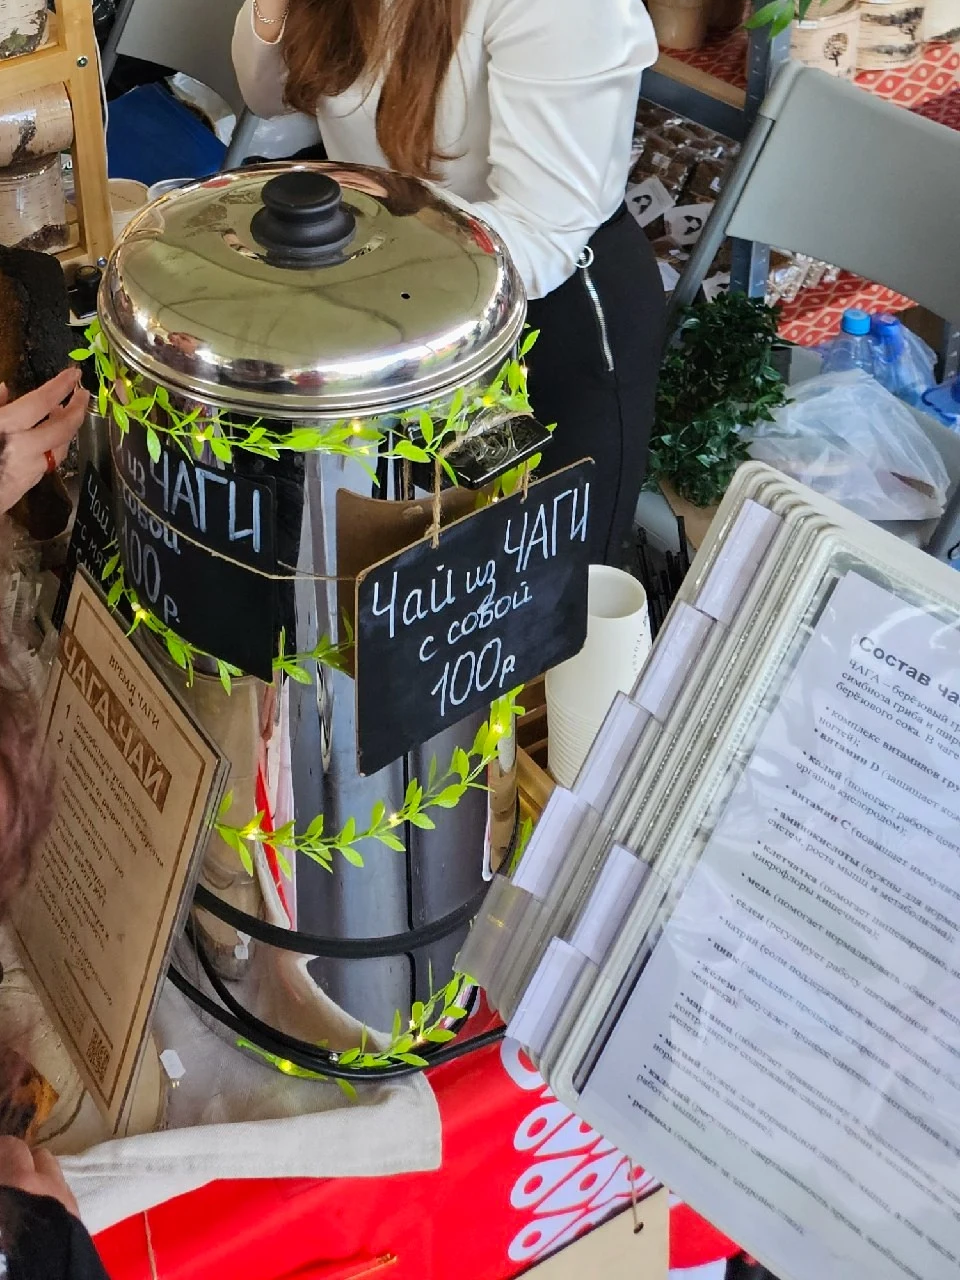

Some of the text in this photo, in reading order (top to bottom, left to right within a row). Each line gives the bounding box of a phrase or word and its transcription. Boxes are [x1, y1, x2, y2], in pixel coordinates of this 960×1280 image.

[149, 451, 262, 553] ЧАГИ
[371, 482, 591, 639] Чай из ЧАГИ
[419, 635, 438, 662] с
[856, 633, 960, 705] Состав ча
[58, 633, 166, 804] ЧАГА-ЧАЙ
[107, 653, 160, 731] ВРЕМЯ ЧАГИ
[832, 679, 895, 723] берёзового
[893, 717, 923, 738] сока.
[923, 733, 935, 745] В
[839, 669, 960, 749] симбиоза гриба и шир
[846, 658, 960, 735] ЧАГА берёзовый гр
[55, 729, 65, 750] 2
[817, 730, 869, 766] витамин
[868, 760, 881, 773] D
[829, 709, 960, 795] комплекс витаминов гру
[787, 787, 840, 824] витамин
[848, 825, 909, 869] (повышает
[792, 760, 911, 838] органов кислородом);
[805, 753, 844, 781] калий
[840, 775, 897, 815] (помогает
[894, 809, 936, 839] работе
[747, 849, 816, 898] микрофлоры
[760, 842, 820, 885] клетчатка
[816, 878, 873, 920] (помогает
[777, 810, 862, 868] аминокислоты
[901, 889, 923, 907] для
[720, 917, 762, 949] натрий
[744, 874, 774, 898] медь
[769, 892, 825, 933] (помогает
[732, 896, 766, 922] селен
[761, 915, 828, 964] (регулирует
[822, 957, 864, 990] работу
